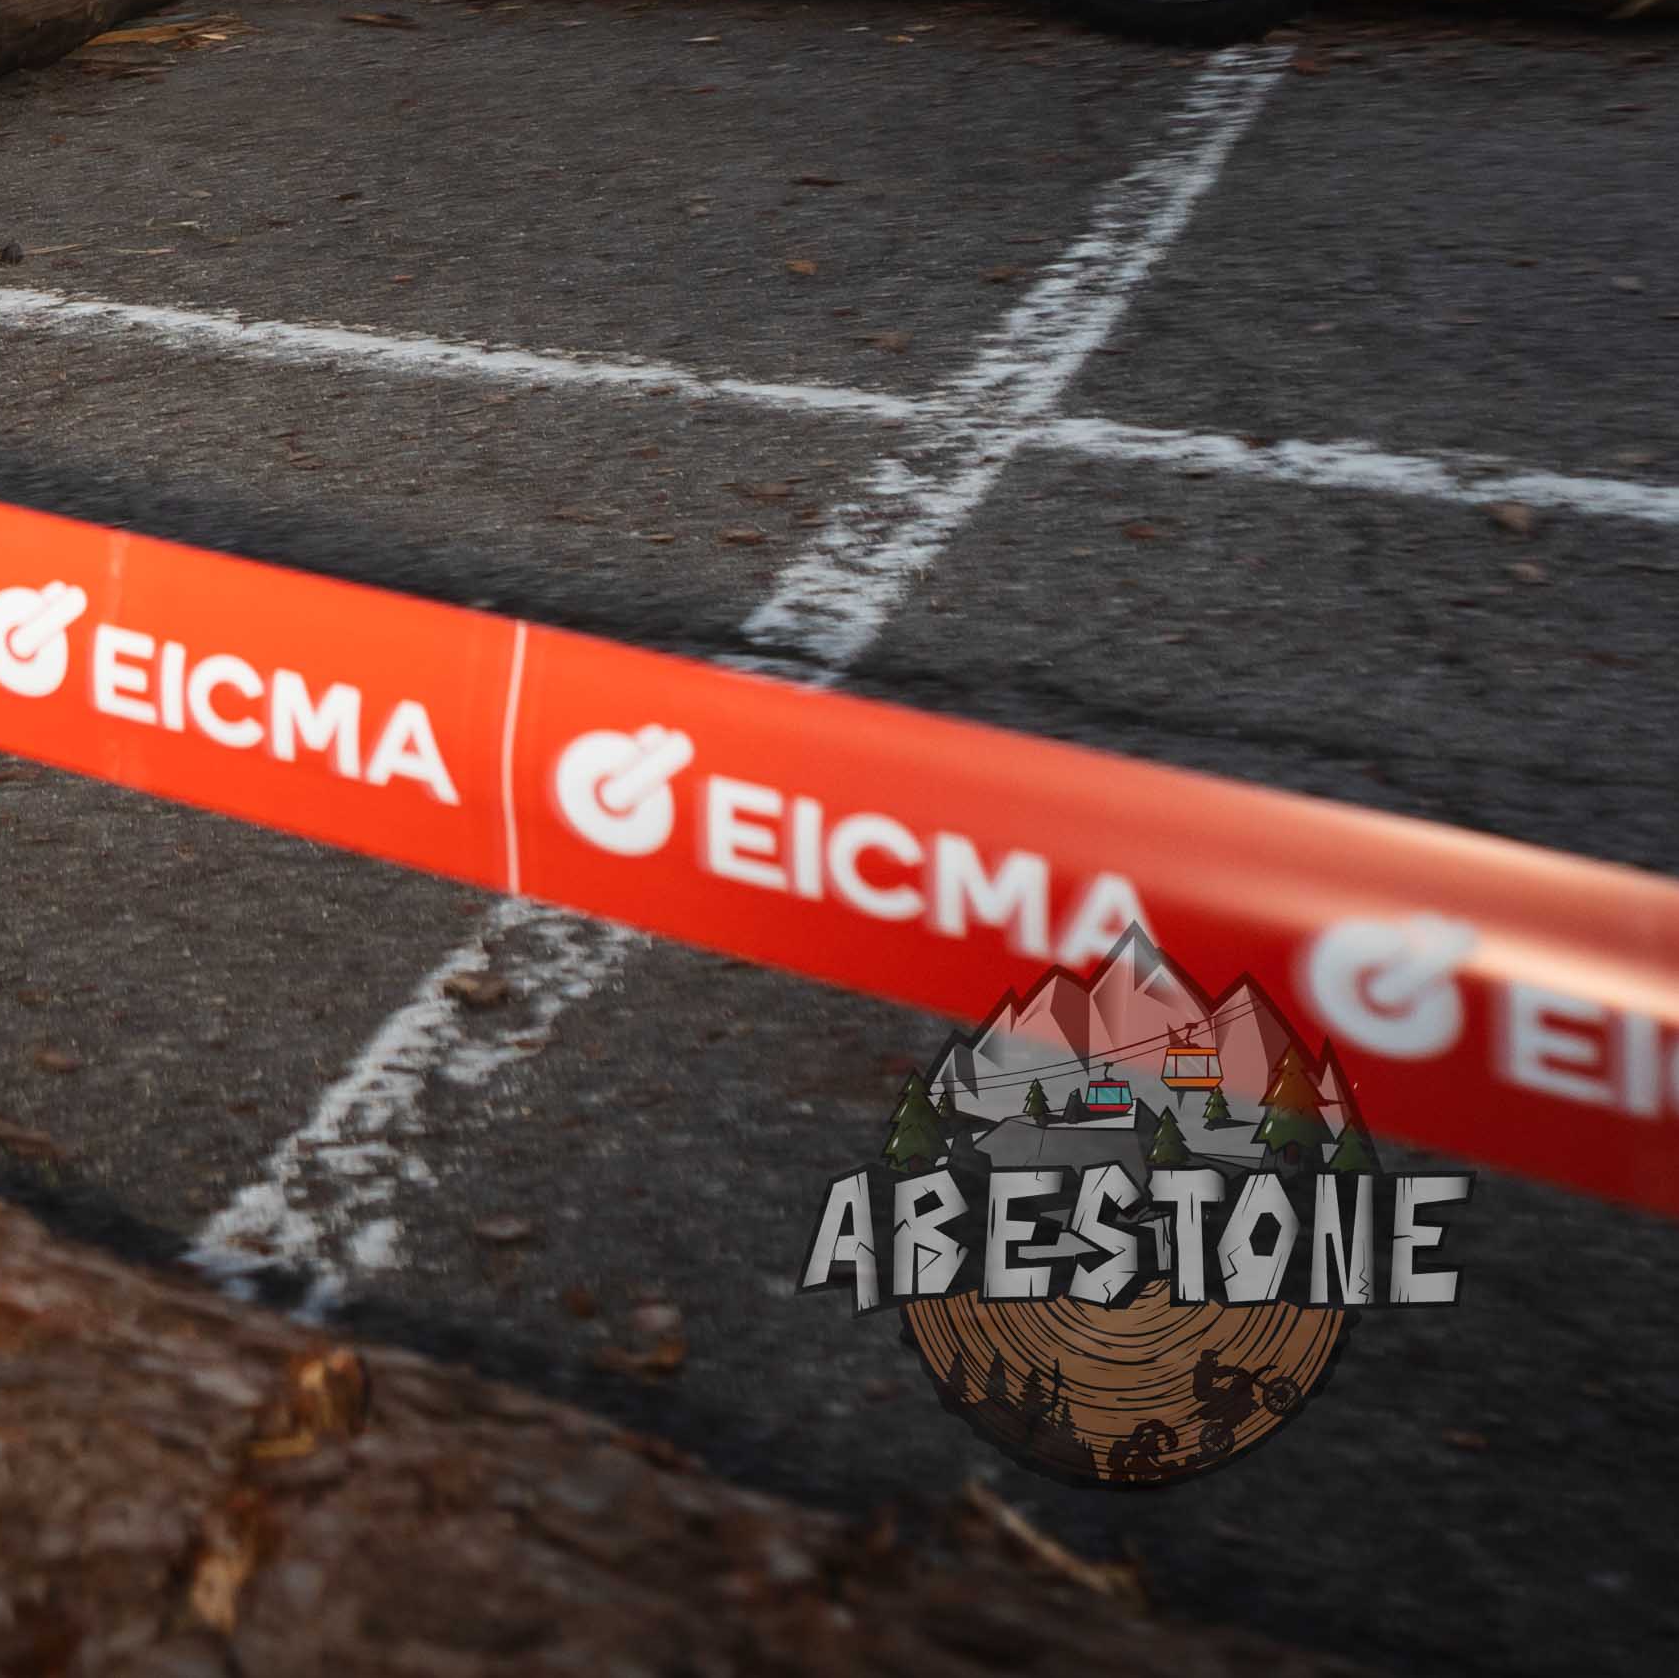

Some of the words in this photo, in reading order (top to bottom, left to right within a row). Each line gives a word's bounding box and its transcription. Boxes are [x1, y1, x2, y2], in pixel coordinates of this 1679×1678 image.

[91, 623, 461, 806] EICMA
[702, 774, 1158, 966] EICMA
[1502, 981, 1679, 1118] EI
